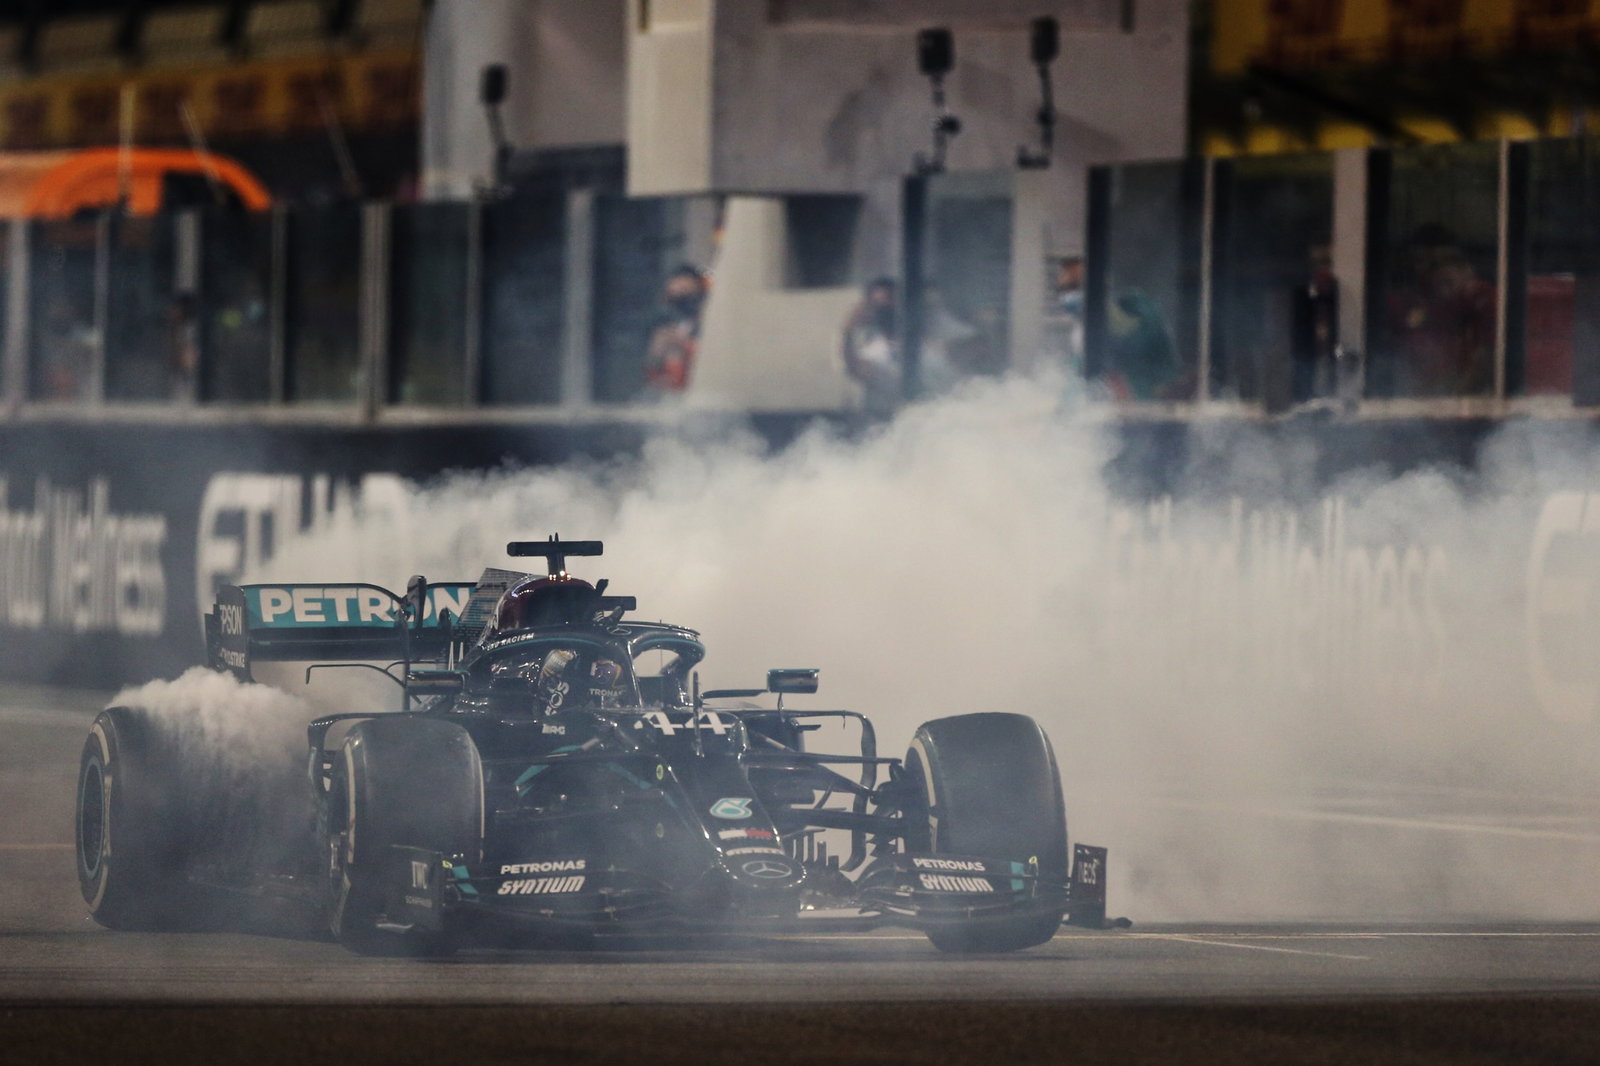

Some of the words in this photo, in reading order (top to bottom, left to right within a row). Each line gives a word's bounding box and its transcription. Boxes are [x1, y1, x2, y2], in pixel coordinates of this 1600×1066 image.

[501, 633, 535, 646] RACISM
[500, 860, 586, 874] PETRONAS
[912, 858, 986, 871] PETRONAS
[497, 876, 586, 895] SYNTIUM
[919, 874, 994, 892] SYNTIUM
